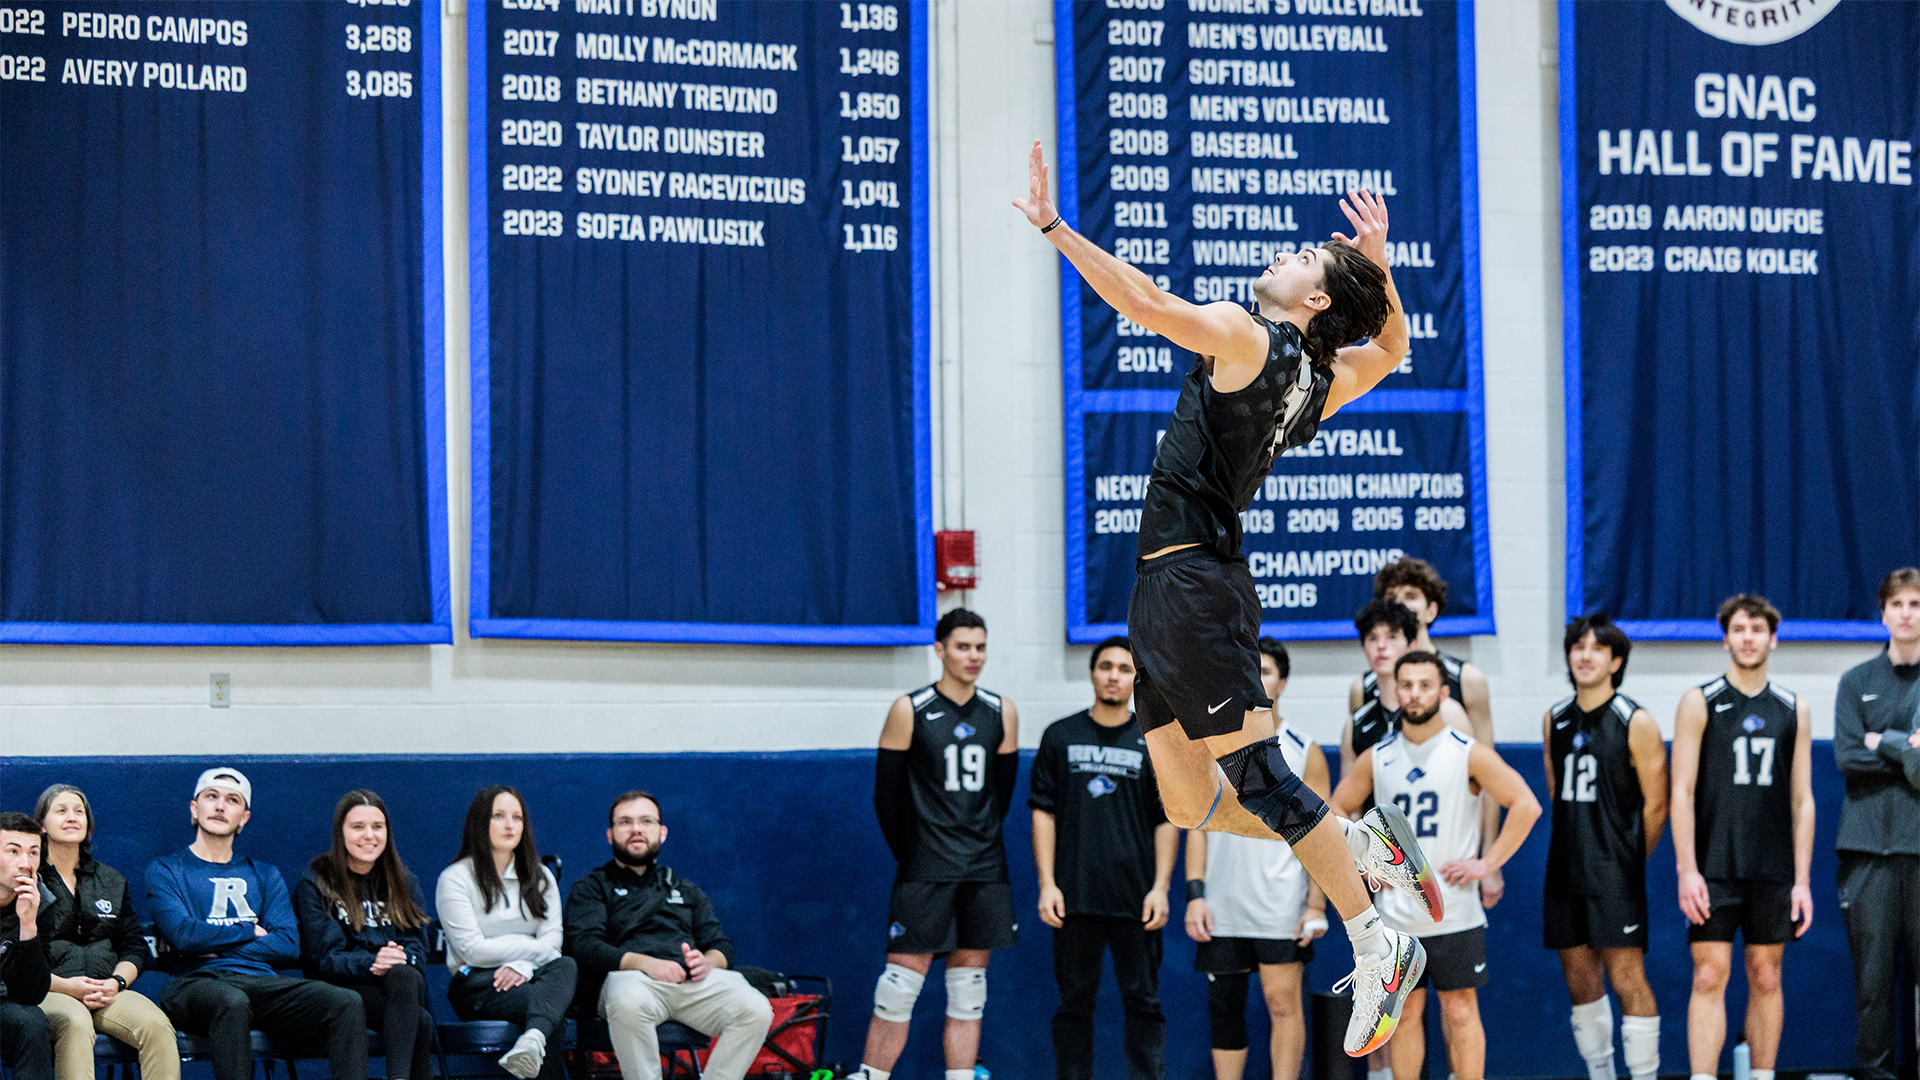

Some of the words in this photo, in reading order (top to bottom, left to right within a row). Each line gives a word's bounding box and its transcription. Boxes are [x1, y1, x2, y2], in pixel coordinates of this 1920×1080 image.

[641, 0, 717, 22] BYNON
[840, 3, 898, 33] 1,136
[1689, 0, 1816, 28] TEGRIT
[0, 8, 45, 36] 022
[62, 11, 141, 40] PEDRO
[146, 15, 248, 47] CAMPOS
[345, 24, 412, 55] 3,268
[1108, 19, 1165, 47] 2007
[1188, 22, 1258, 51] MEN'S
[1259, 24, 1388, 53] VOLLEYBALL
[503, 29, 560, 57] 2017
[576, 32, 649, 63] MOLLY
[652, 36, 798, 71] McCORMACK
[839, 47, 900, 77] 1,246
[0, 54, 46, 82] 022
[61, 58, 138, 87] AVERY
[143, 62, 247, 93] POLLARD
[346, 70, 413, 100] 3,085
[1108, 56, 1166, 84] 2007
[1188, 58, 1296, 87] SOFTBALL
[502, 73, 562, 103] 2018
[576, 77, 679, 109] BETHANY
[680, 83, 778, 115] TREVINO
[839, 91, 900, 121] 1,850
[1108, 92, 1168, 120] 2008
[1190, 94, 1259, 123] MEN'S
[1261, 96, 1390, 125] VOLLEYBALL
[1694, 73, 1817, 123] GNAC
[501, 119, 563, 147] 2020
[576, 122, 660, 153] TAYLOR
[664, 127, 765, 159] DUNSTER
[841, 135, 900, 165] 1,057
[1109, 128, 1169, 156] 2008
[1190, 131, 1299, 160] BASEBALL
[1598, 129, 1712, 176] HALL
[1720, 130, 1780, 178] OF
[1790, 134, 1912, 186] FAME
[502, 164, 563, 193] 2022
[576, 167, 666, 198] SYDNEY
[668, 171, 806, 205] RACEVICIUS
[842, 179, 901, 209] 1,041
[1110, 164, 1170, 192] 2009
[1191, 167, 1261, 195] MEN'S
[1264, 169, 1398, 196] BASKETBALL
[502, 209, 564, 237] 2023
[576, 212, 646, 242] SOFIA
[649, 215, 765, 247] PAWLUSIK
[843, 223, 898, 254] 1,116
[1114, 201, 1168, 229] 2011
[1192, 203, 1299, 231] SOFTBALL
[1590, 204, 1652, 231] 2019
[1663, 205, 1746, 232] AARON
[1749, 206, 1824, 235] DUFOE
[1114, 237, 1171, 265] 2012
[1589, 245, 1654, 272] 2023
[1664, 246, 1742, 273] CRAIG
[1746, 247, 1818, 275] KOLEK
[1193, 275, 1256, 303] SOFT
[1117, 346, 1173, 374] 2014
[1264, 474, 1354, 501] DIVISION
[1355, 472, 1464, 499] CHAMPIONS
[1238, 508, 1276, 534] 003
[1287, 508, 1340, 533] 2004
[1351, 506, 1404, 532] 2005
[1414, 505, 1466, 531] 2006
[1248, 548, 1406, 578] CHAMPIONS
[1254, 583, 1317, 608] 2006
[944, 743, 986, 791] 19
[1561, 753, 1597, 802] 12
[1733, 736, 1775, 786] 17
[208, 876, 257, 918] R
